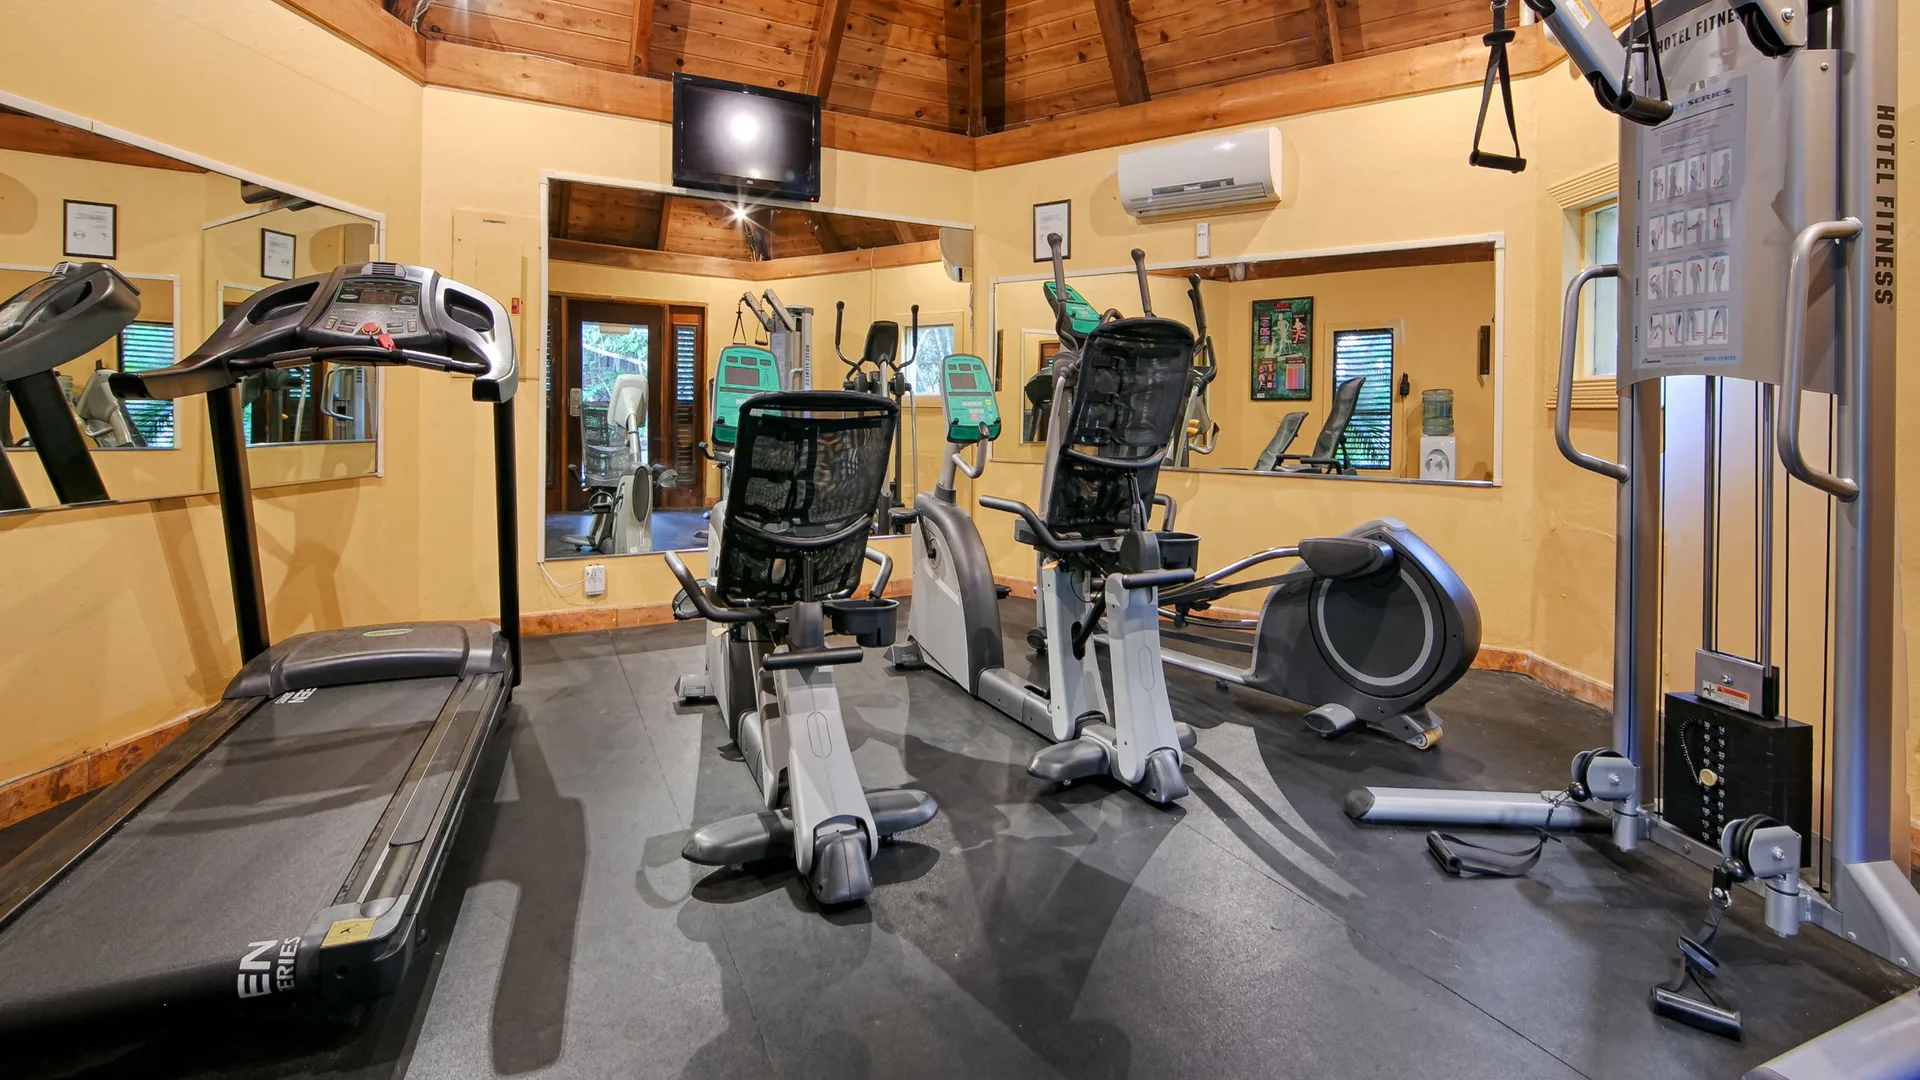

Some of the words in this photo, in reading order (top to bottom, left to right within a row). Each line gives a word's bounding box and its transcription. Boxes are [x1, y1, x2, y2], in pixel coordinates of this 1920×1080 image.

[1656, 27, 1691, 54] HOTEL
[1696, 8, 1736, 37] FITNE
[1687, 87, 1732, 106] SERIES
[1876, 105, 1895, 184] HOTEL
[1875, 196, 1894, 304] FITNESS
[237, 940, 278, 998] EN
[276, 936, 301, 991] ERIES
